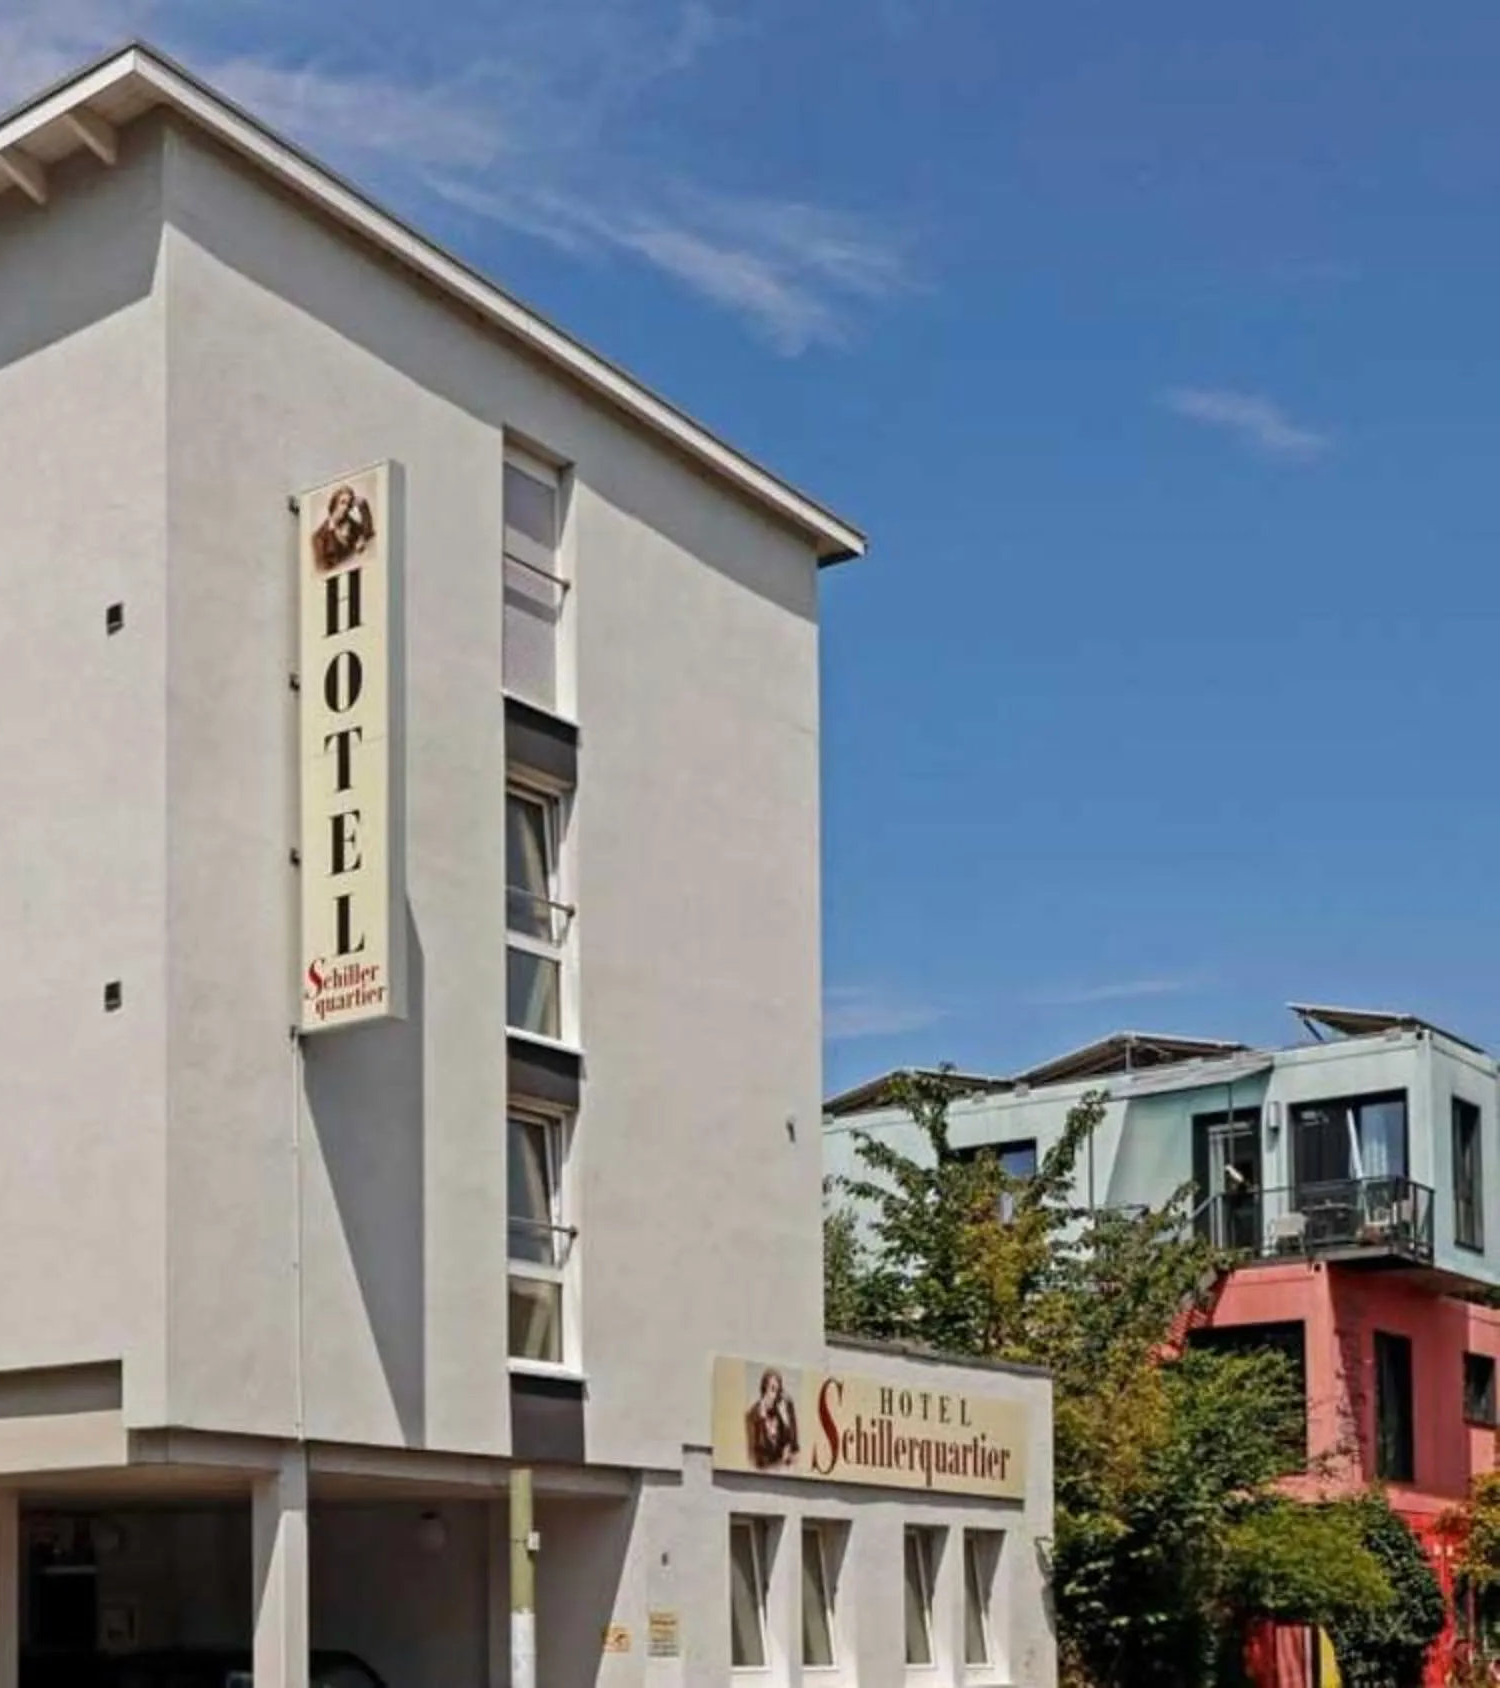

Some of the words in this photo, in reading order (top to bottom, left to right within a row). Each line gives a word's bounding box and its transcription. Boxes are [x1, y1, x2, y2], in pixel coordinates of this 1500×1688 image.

[324, 568, 366, 957] HOTEL
[304, 957, 380, 1000] Schiller
[314, 985, 388, 1021] quartier
[879, 1386, 972, 1427] HOTEL
[811, 1376, 1012, 1488] Schillerquartier
